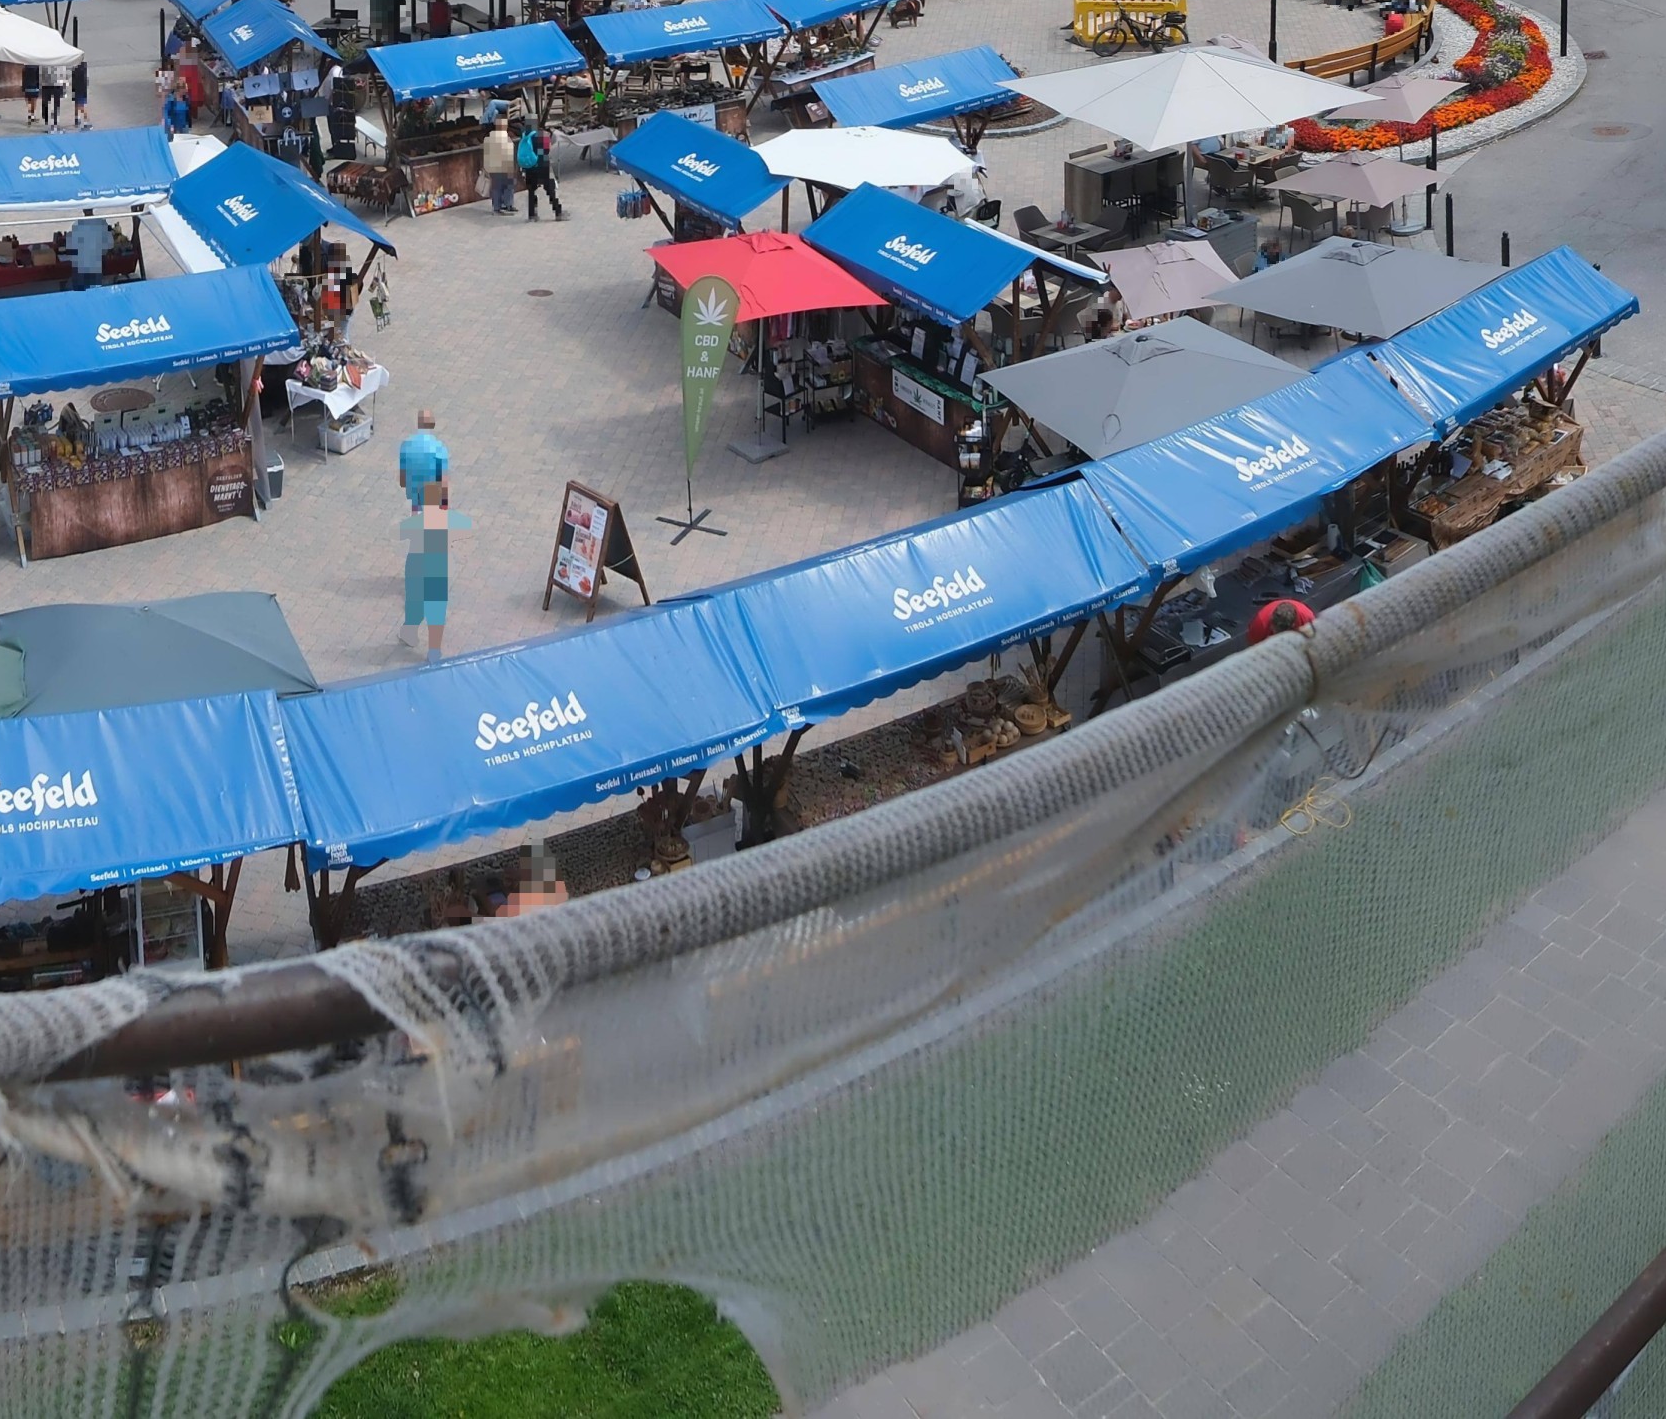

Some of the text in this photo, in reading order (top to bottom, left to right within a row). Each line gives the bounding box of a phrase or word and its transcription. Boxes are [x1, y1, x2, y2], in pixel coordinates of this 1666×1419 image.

[664, 16, 708, 32] Seefeld
[456, 50, 503, 67] Seefeld
[899, 76, 945, 98] Seefeld
[19, 153, 80, 172] Seefeld
[677, 152, 721, 177] Seefeld
[885, 235, 938, 265] Seefeld
[95, 314, 171, 342] Seefeld
[1480, 308, 1538, 349] Seefeld
[694, 335, 719, 347] CBD
[701, 351, 709, 363] &
[686, 366, 720, 379] HANF
[1235, 435, 1310, 483] Seefeld
[892, 564, 986, 621] Seefeld
[903, 595, 994, 634] TIROLS HOCHPLATEAU
[475, 690, 587, 752] Seefeld
[484, 729, 593, 768] TIROLS HOCHPLATEAU
[595, 726, 768, 793] Seefeld Leutasch Mösern Reith Scharnitz
[18, 816, 99, 833] HOCHPLATEAU
[90, 869, 119, 882] Seefeld
